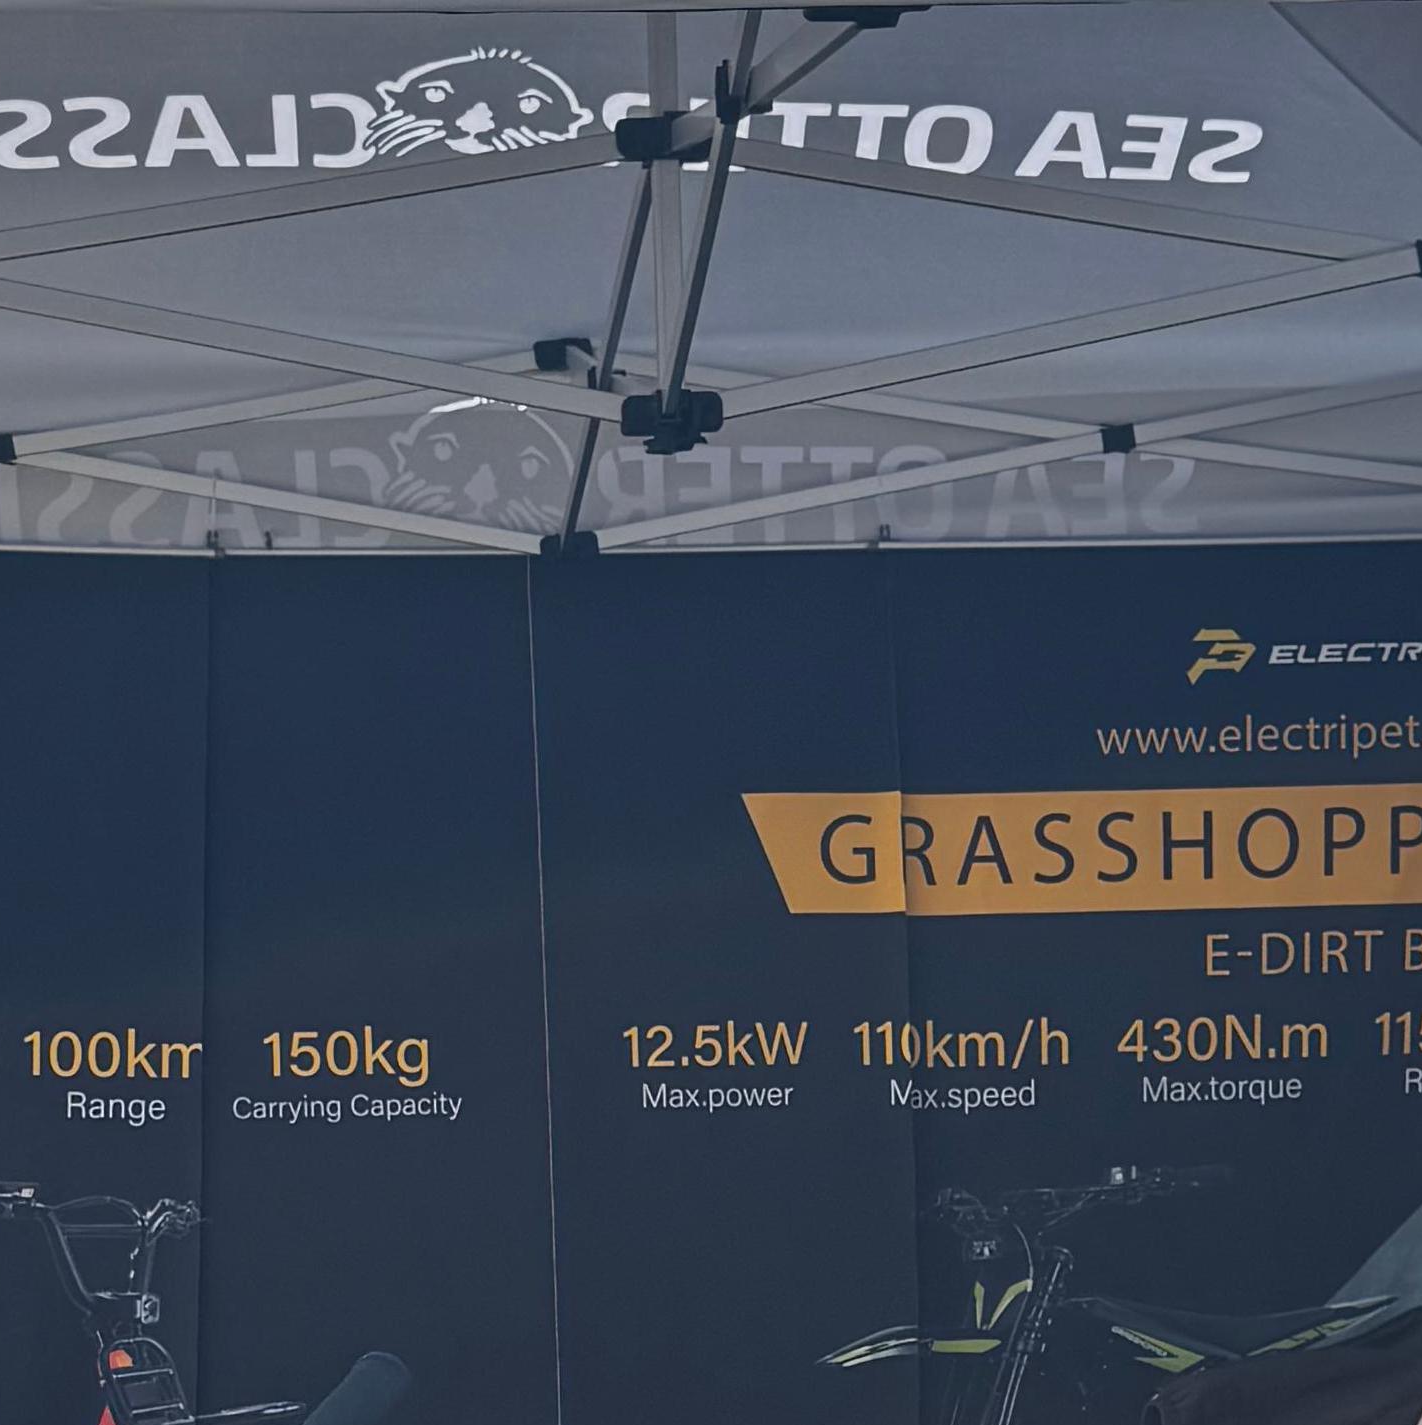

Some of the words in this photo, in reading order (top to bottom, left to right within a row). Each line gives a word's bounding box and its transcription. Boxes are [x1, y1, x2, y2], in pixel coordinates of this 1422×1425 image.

[1205, 930, 1384, 977] E-DIRT
[23, 1028, 203, 1080] 100km
[262, 1025, 432, 1088] 150kg
[622, 1019, 809, 1069] 12.5kW
[853, 1016, 1070, 1070] 110km/h
[1116, 1012, 1329, 1063] 430N.m
[65, 1090, 166, 1127] Range
[232, 1096, 343, 1124] Carrying
[350, 1091, 463, 1122] Capacity
[642, 1082, 794, 1113] Max.power
[889, 1078, 1036, 1114] Max.speed
[1142, 1075, 1303, 1105] Max.torque
